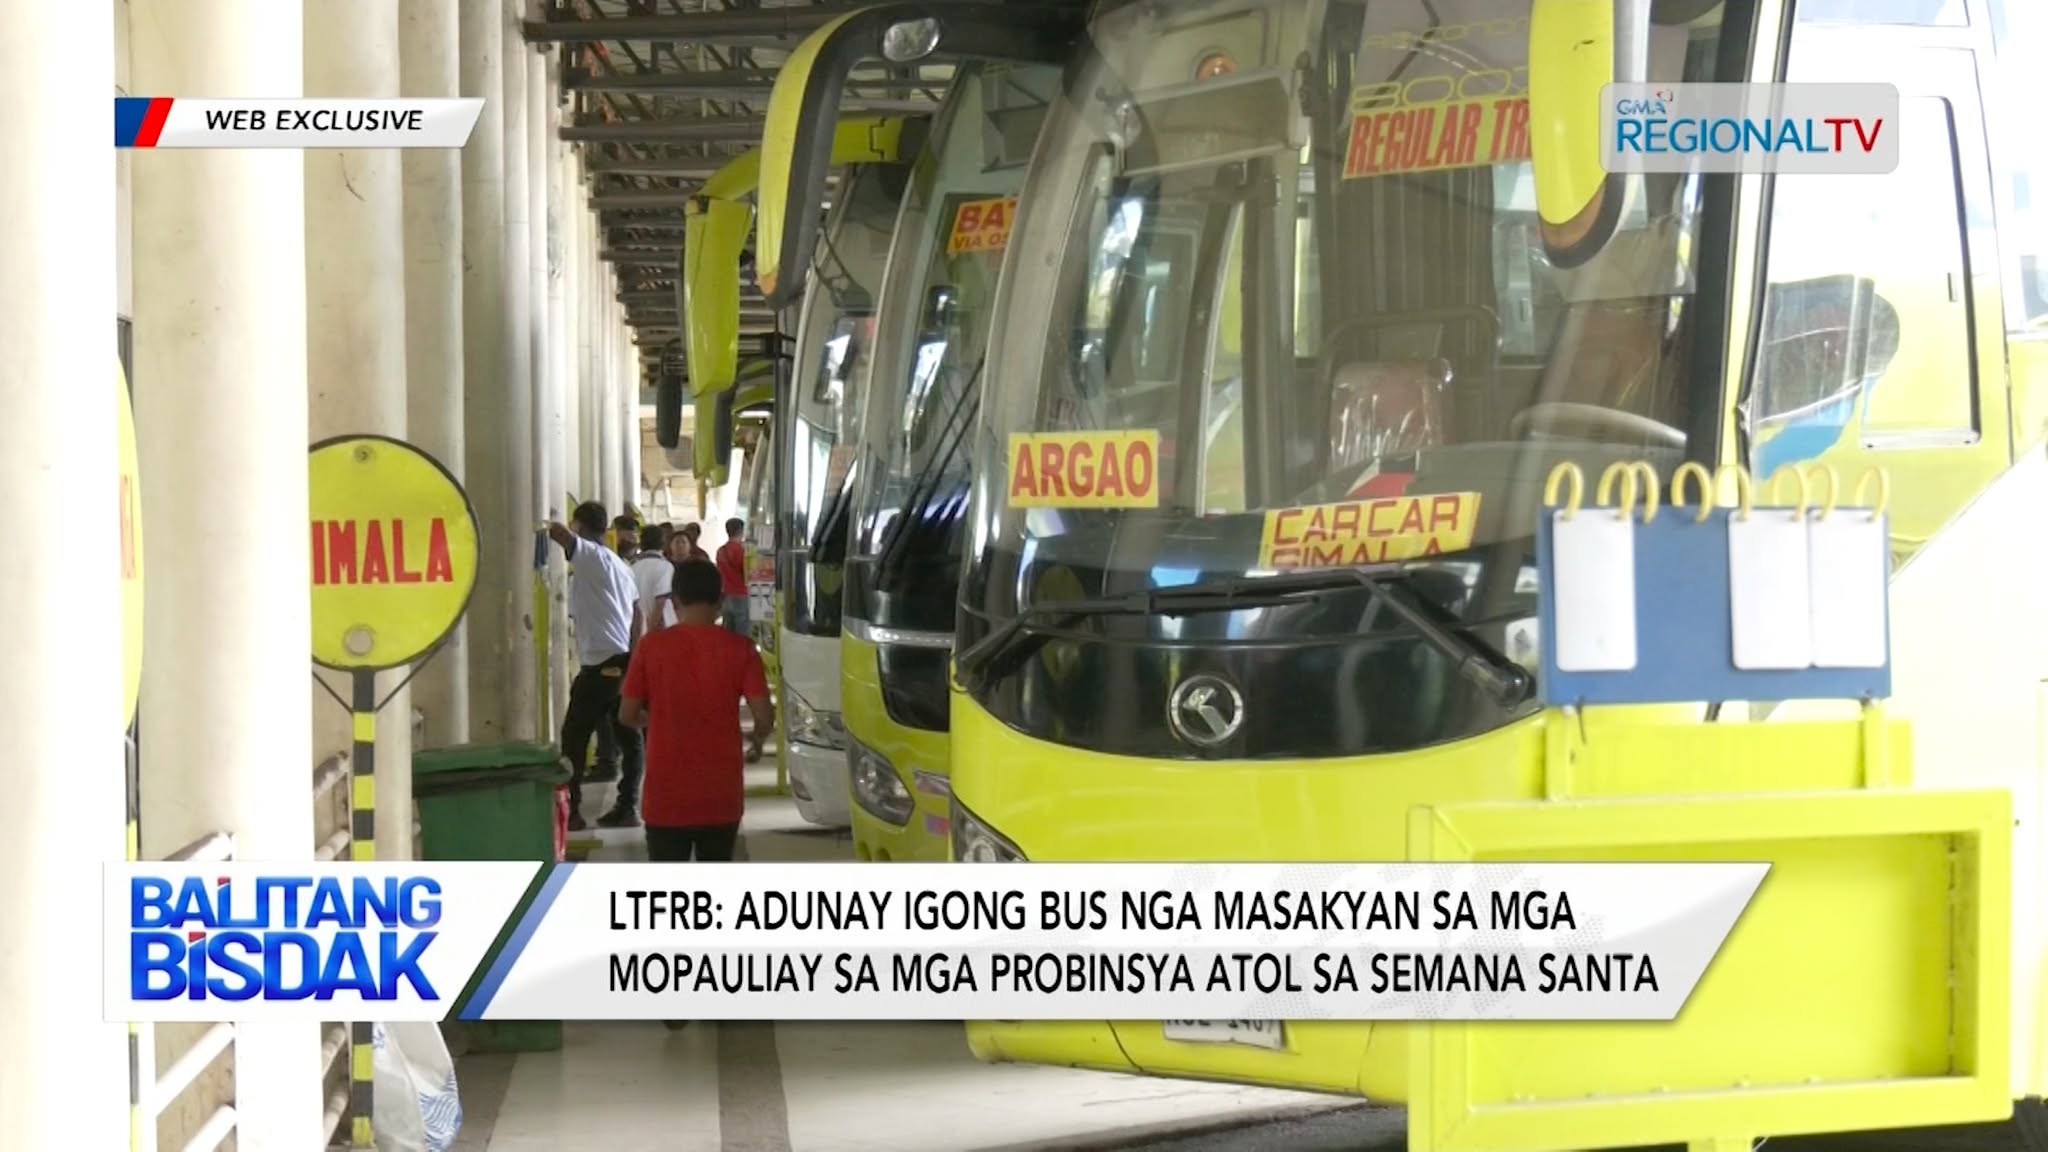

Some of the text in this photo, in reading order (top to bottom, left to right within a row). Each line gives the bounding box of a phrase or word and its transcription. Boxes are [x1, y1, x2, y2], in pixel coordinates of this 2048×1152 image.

[1345, 103, 1482, 175] REGULAR
[954, 235, 982, 249] VIA
[1011, 440, 1153, 497] ARGAO
[1273, 495, 1461, 545] CARCAR
[311, 517, 454, 585] IMALA
